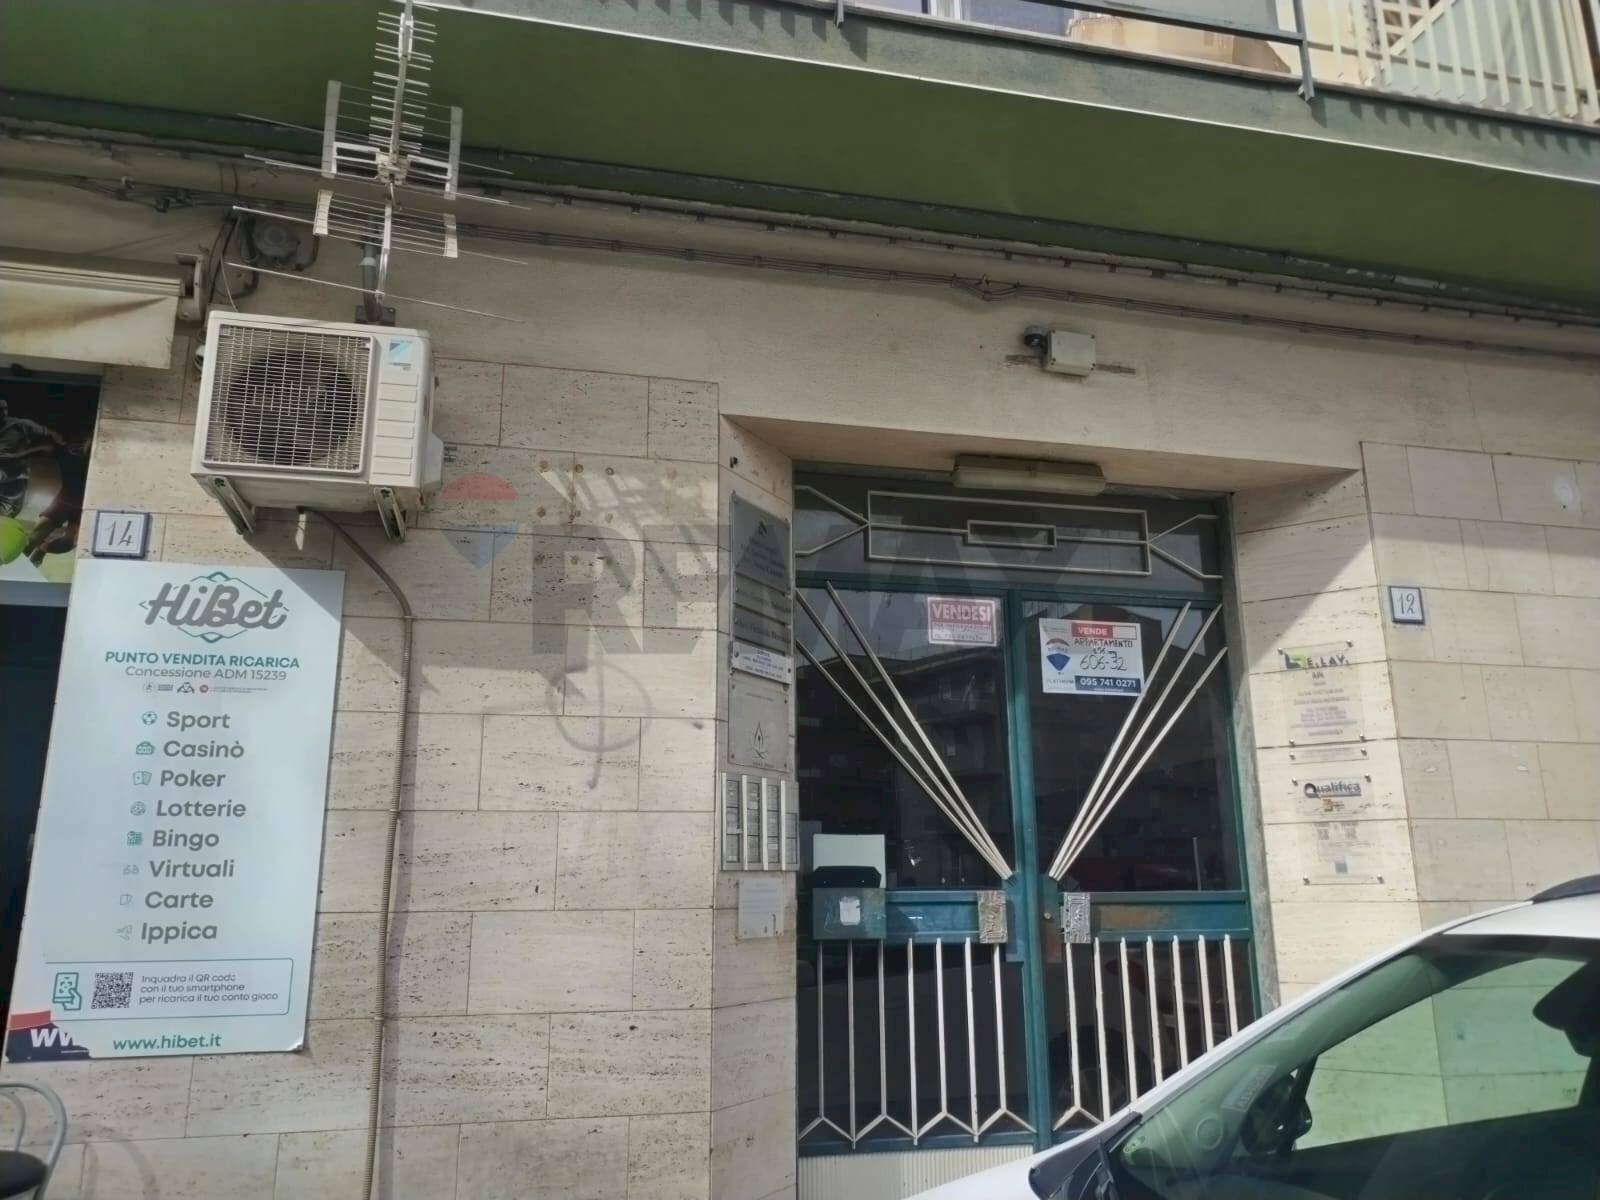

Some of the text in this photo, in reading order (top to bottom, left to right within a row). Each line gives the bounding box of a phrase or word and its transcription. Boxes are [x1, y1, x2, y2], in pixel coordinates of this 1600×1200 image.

[106, 519, 134, 548] 14
[144, 581, 289, 631] HiBet
[931, 603, 991, 623] VENDESI
[1398, 592, 1416, 616] 12
[1078, 626, 1108, 635] VENDE
[1074, 637, 1133, 648] APPARTAMENTO
[105, 650, 300, 670] PUNTO VENDITA RICARICA
[125, 665, 287, 682] Concessione ADM 15239
[1079, 678, 1098, 687] 095
[1100, 679, 1114, 687] 741
[1115, 679, 1136, 688] 0271
[166, 710, 231, 732] Sport
[163, 739, 245, 759] Casinò
[160, 769, 226, 788] Poker
[1303, 781, 1362, 800] Qualifica
[156, 799, 247, 818] Lotterie
[152, 829, 220, 852] Bingo
[149, 859, 235, 878] Virtuali
[145, 890, 214, 910] Carte
[140, 921, 218, 945] Ippica
[140, 983, 245, 993] con il tuo smartphone
[141, 974, 186, 984] Inquadra
[188, 973, 195, 983] il
[195, 973, 210, 983] QR
[138, 992, 279, 1005] per ricarica il tuo conto gioco
[113, 1033, 222, 1051] www.hibet.it
